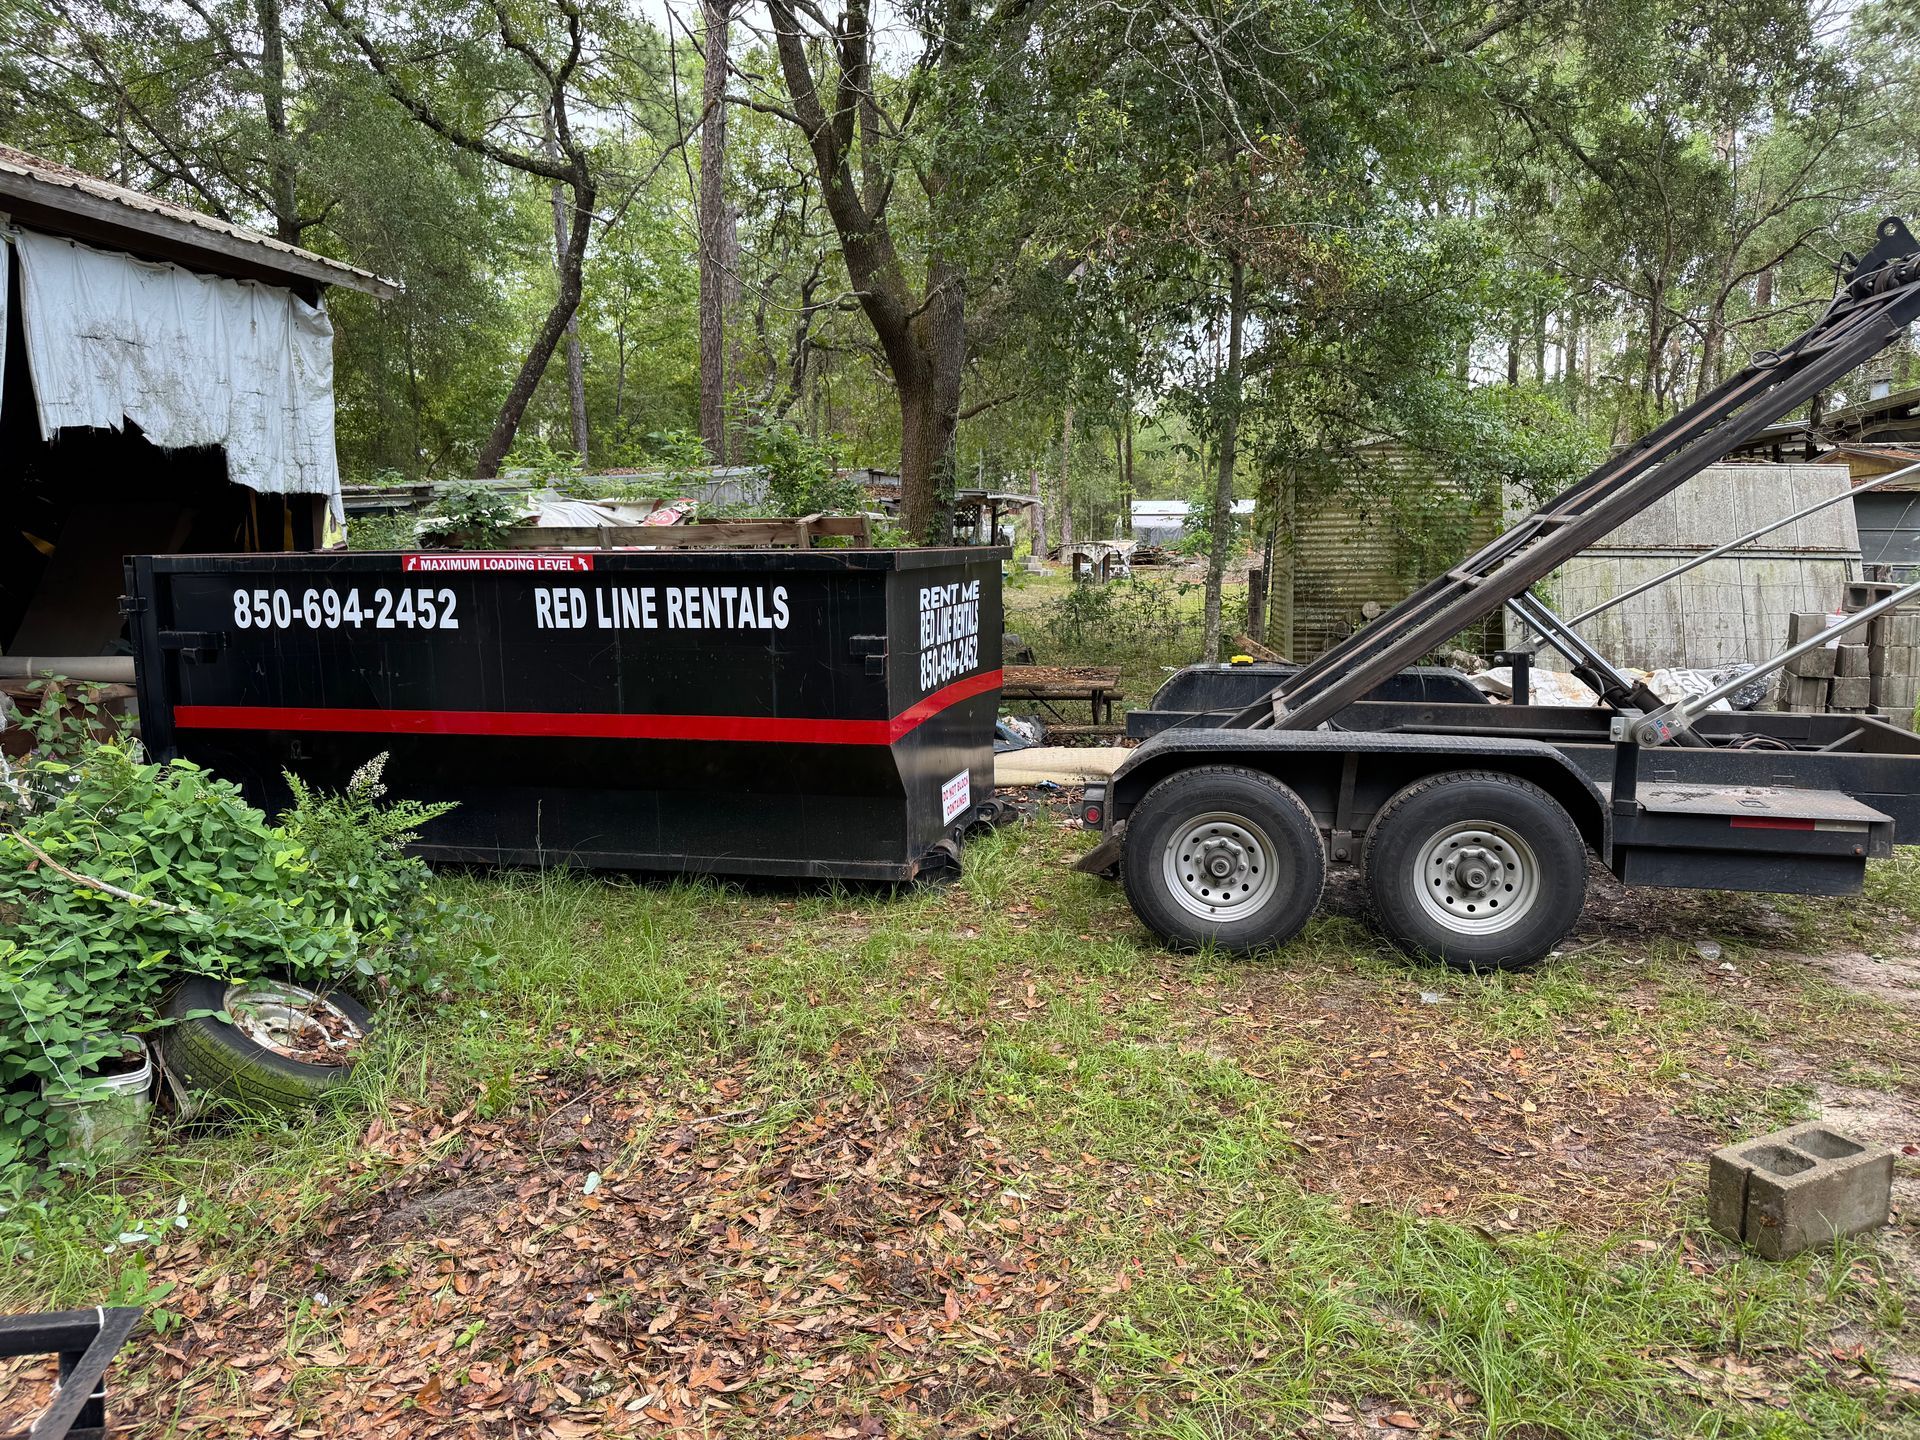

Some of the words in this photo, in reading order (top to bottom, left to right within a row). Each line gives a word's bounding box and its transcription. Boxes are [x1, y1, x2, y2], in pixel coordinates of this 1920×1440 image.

[420, 559, 480, 571] MAXIMUM
[483, 559, 535, 571] LOADING
[537, 559, 575, 571] LEVEL
[233, 588, 459, 629] 850-694-2452
[534, 587, 588, 629] RED
[595, 587, 659, 629] LINE
[665, 585, 790, 629] RENTALS
[920, 583, 960, 611] RENT
[961, 579, 980, 602] ME
[920, 609, 935, 651] RED
[936, 605, 952, 646] LINE
[952, 600, 979, 640] RENTALS
[920, 634, 979, 692] 850-694-2452
[943, 789, 949, 802] DO
[949, 783, 957, 797] NOT
